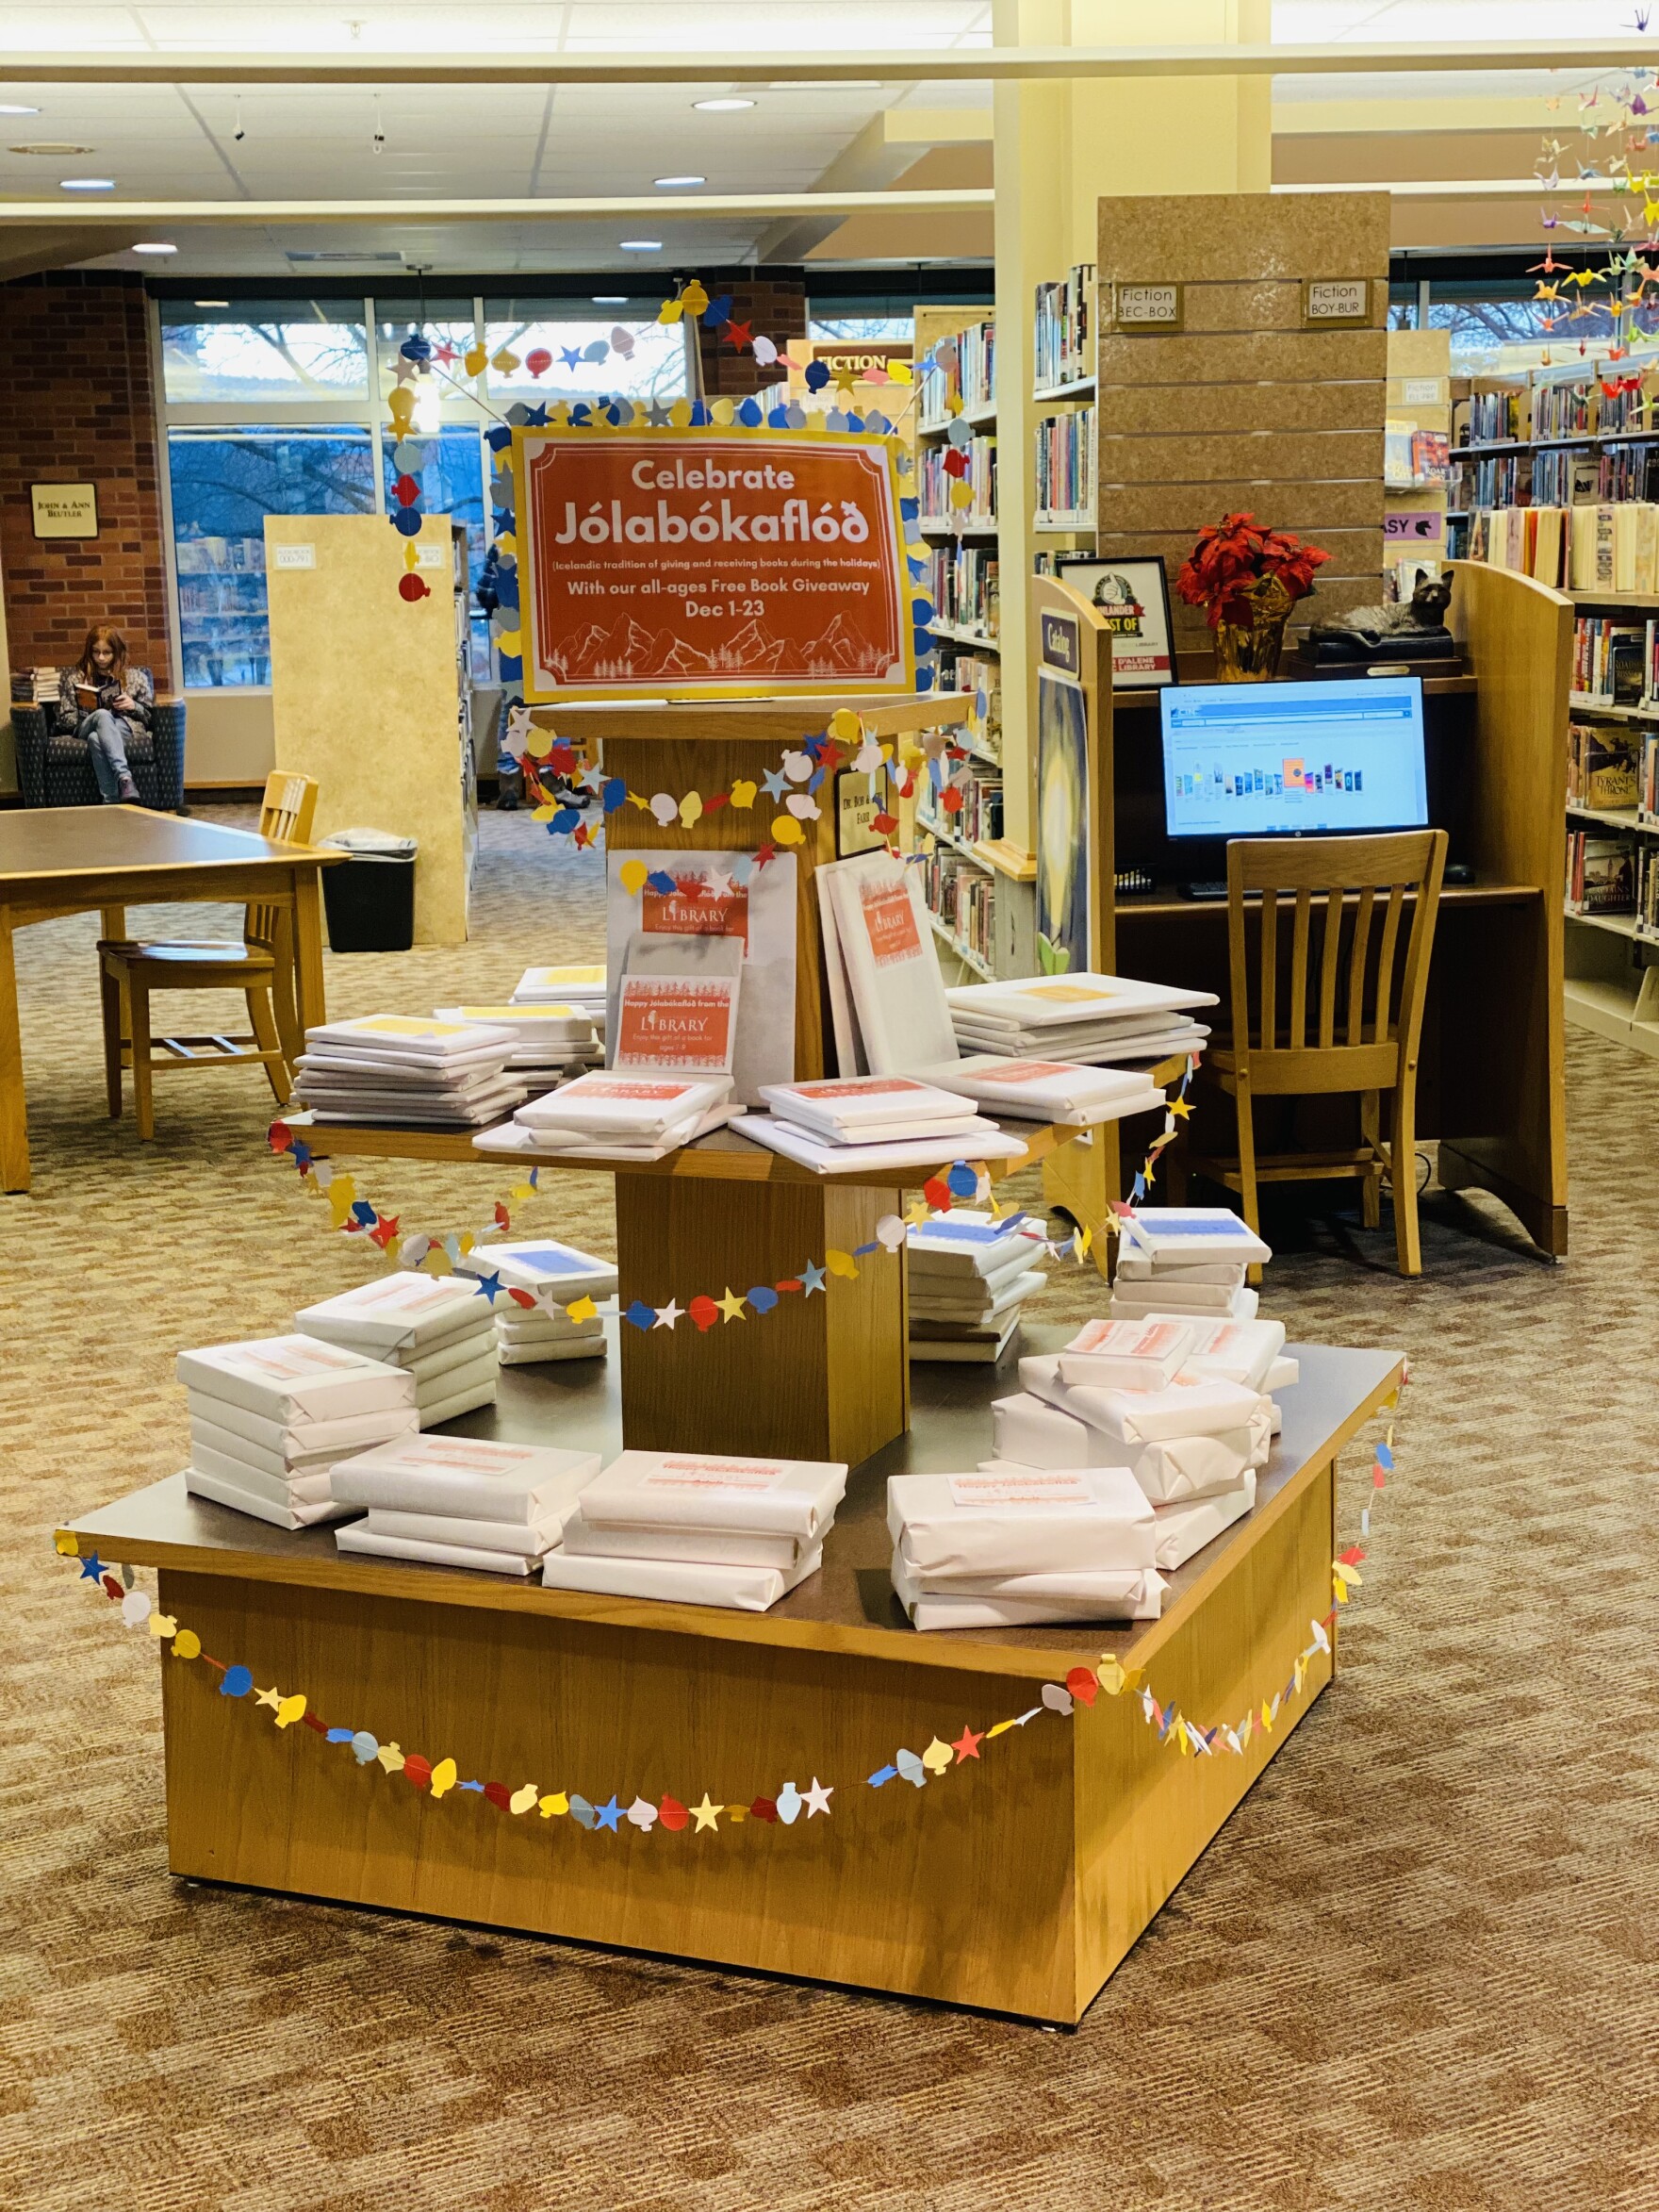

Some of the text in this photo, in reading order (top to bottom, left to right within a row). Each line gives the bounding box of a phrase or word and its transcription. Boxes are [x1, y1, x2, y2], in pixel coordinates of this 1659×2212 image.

[1122, 289, 1173, 301] Fiction
[1313, 285, 1357, 298] Fiction
[1118, 306, 1177, 317] BEC-BOX
[1311, 302, 1359, 315] BOY-BUR
[1407, 384, 1436, 392] Fiction
[632, 458, 795, 490] Celebrate
[38, 501, 59, 510] JOHN
[71, 501, 90, 509] ANN
[47, 509, 82, 518] BEUTLER
[554, 499, 869, 544] Jólabókaflóð
[552, 557, 881, 571] (Icelandic tradition of giving and receiving books during the holidays)
[567, 577, 870, 597] With our all-ages Free Book Giveaway
[685, 599, 765, 617] Dec 1-23
[1124, 617, 1138, 631] OF
[1047, 622, 1071, 663] Catalog
[736, 890, 747, 899] the
[663, 901, 728, 923] LIBRARY
[875, 910, 905, 932] LIBRARY
[624, 999, 648, 1008] Happy
[698, 999, 715, 1008] from
[717, 999, 730, 1008] the
[640, 1010, 709, 1032] LIBRARY
[632, 1033, 649, 1042] Enjoy
[662, 1033, 673, 1042] gift
